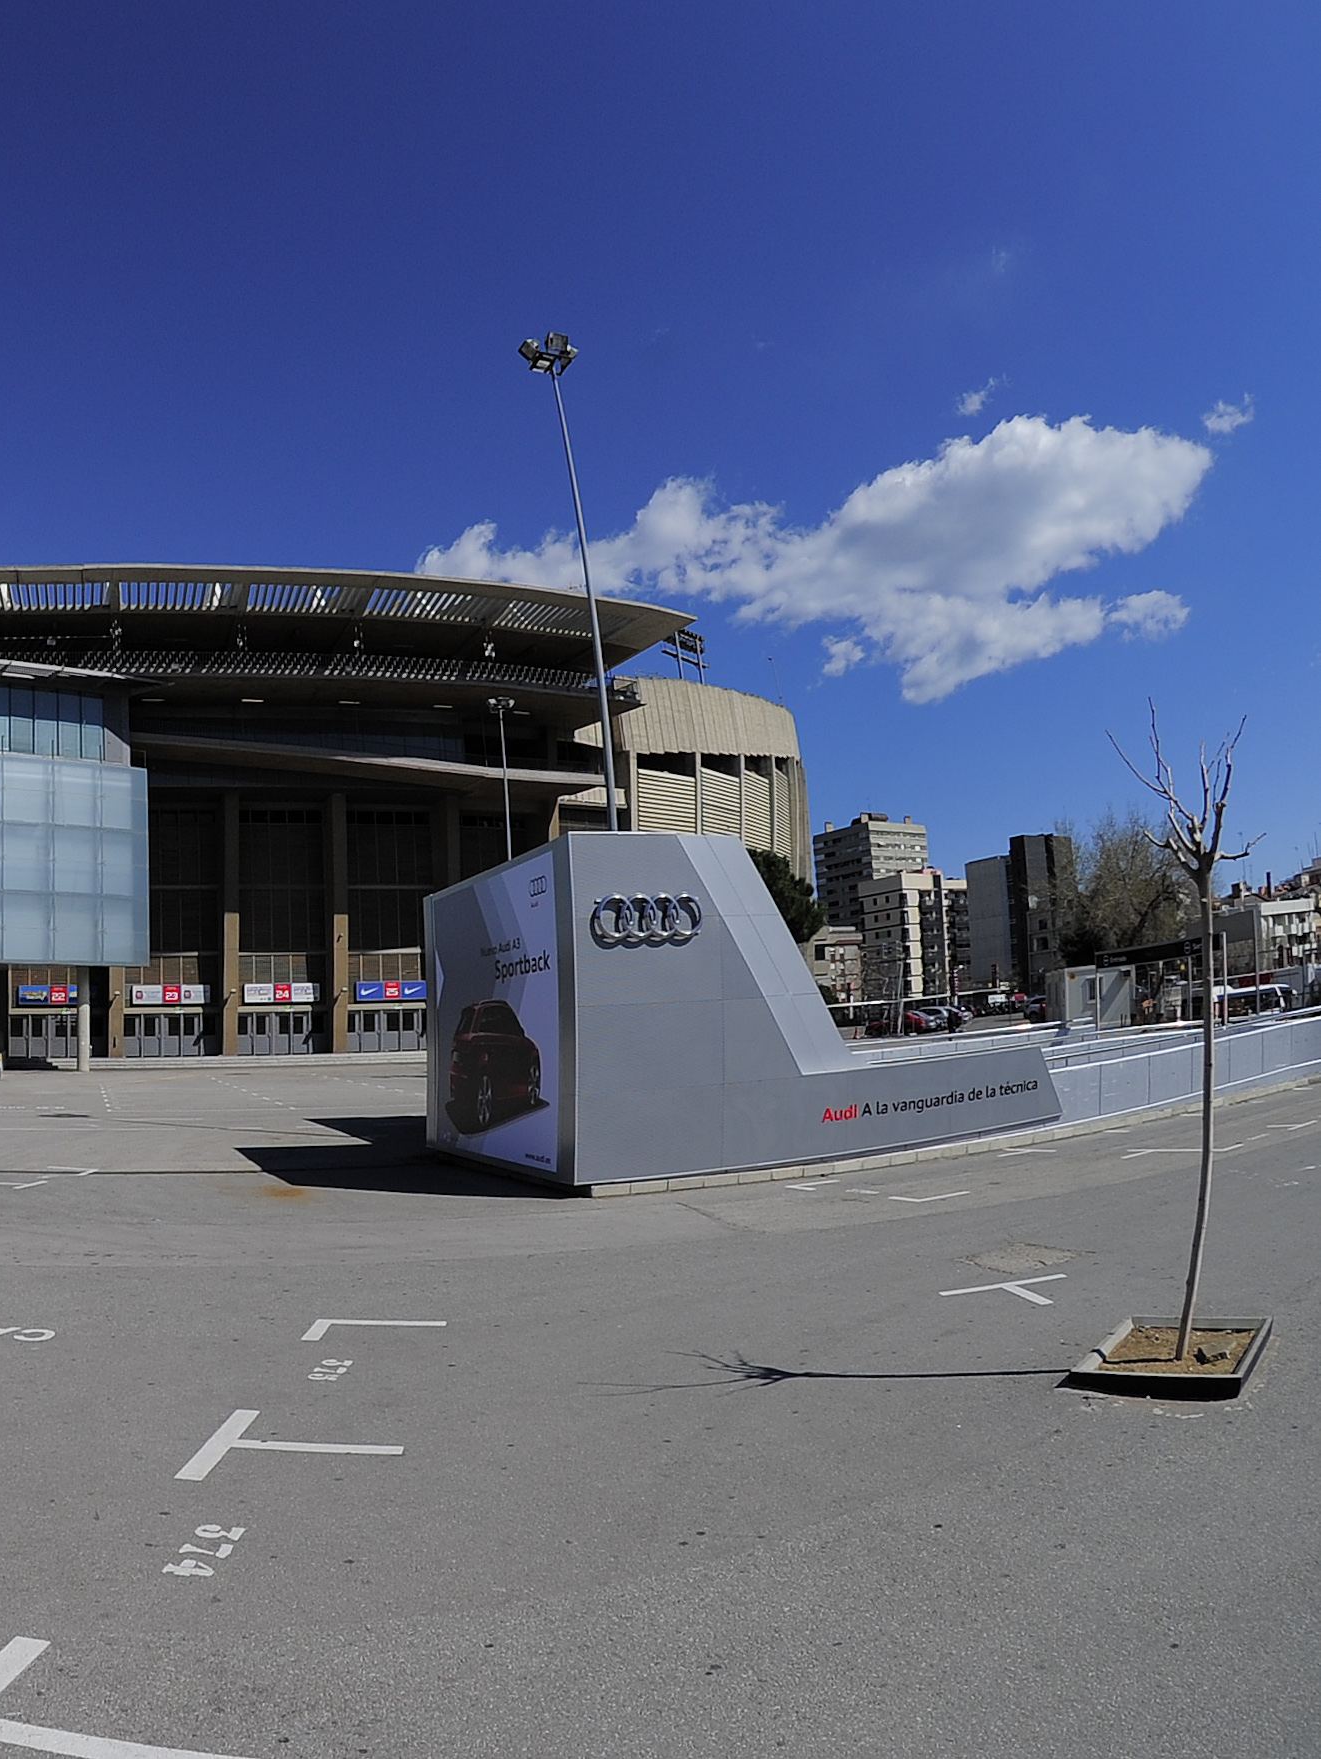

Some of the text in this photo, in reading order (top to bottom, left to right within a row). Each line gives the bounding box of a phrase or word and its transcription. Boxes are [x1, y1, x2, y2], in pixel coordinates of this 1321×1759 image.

[511, 937, 521, 951] A3
[494, 949, 551, 984] Sportback
[275, 990, 289, 999] 24
[386, 987, 399, 996] 25
[51, 992, 66, 1001] 22
[165, 992, 179, 1001] 23
[821, 1079, 1039, 1123] Audi A la vanguardia de la técnica
